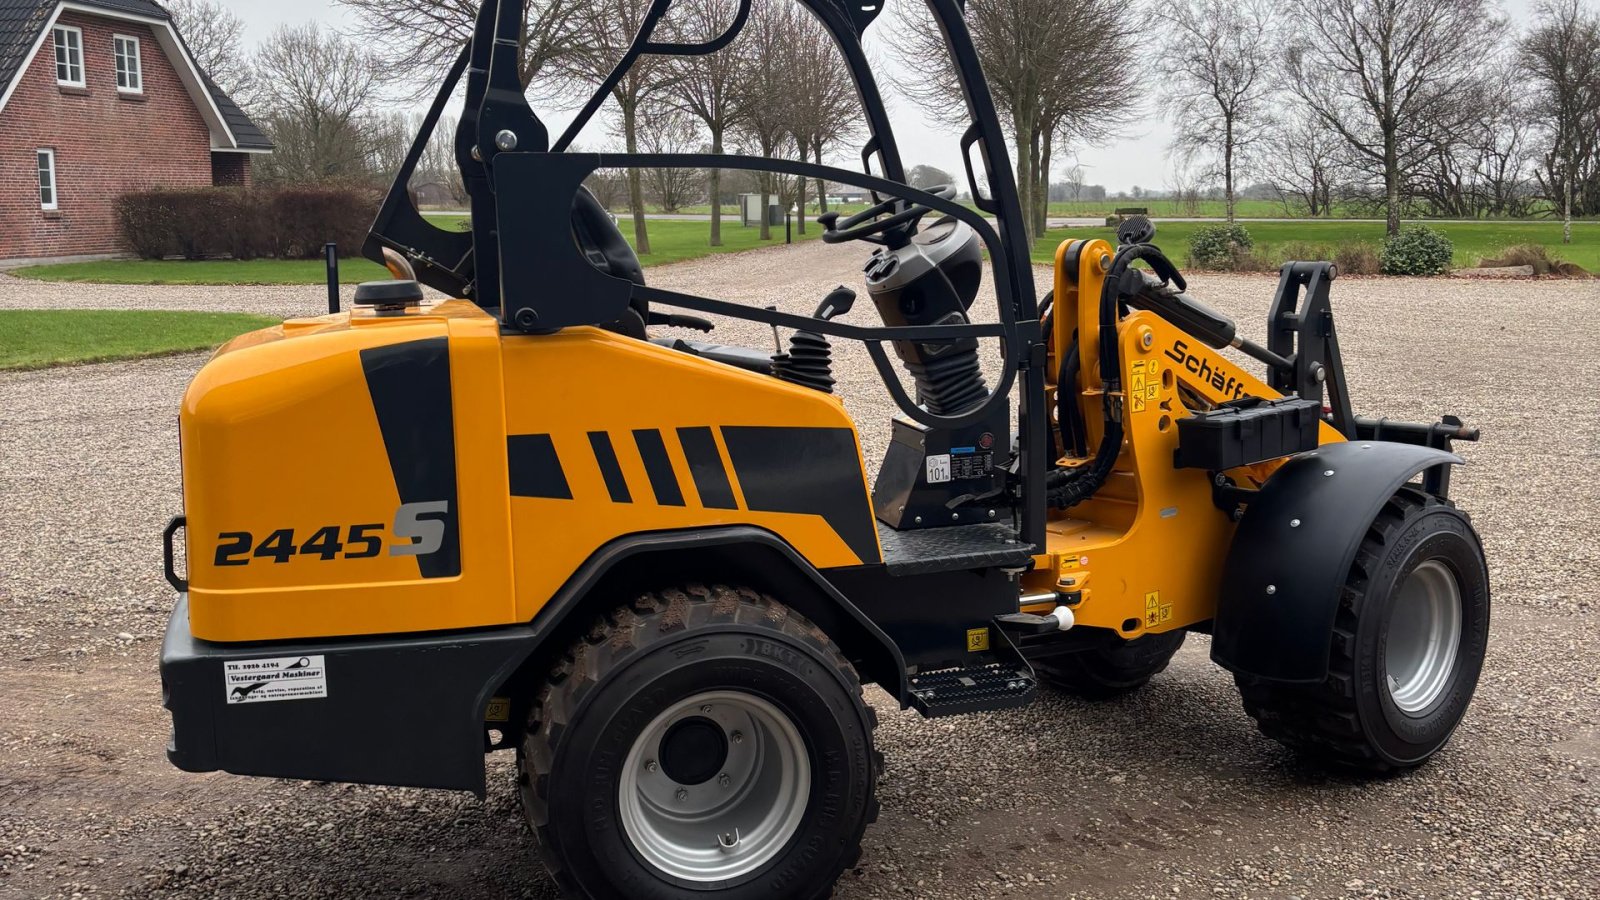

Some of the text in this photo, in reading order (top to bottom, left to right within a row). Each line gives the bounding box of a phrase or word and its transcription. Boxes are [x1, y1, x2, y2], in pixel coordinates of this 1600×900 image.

[1164, 340, 1250, 399] Schäff
[929, 467, 945, 481] 101
[761, 643, 796, 663] BKT
[231, 670, 320, 682] Vestergaard Maskiner
